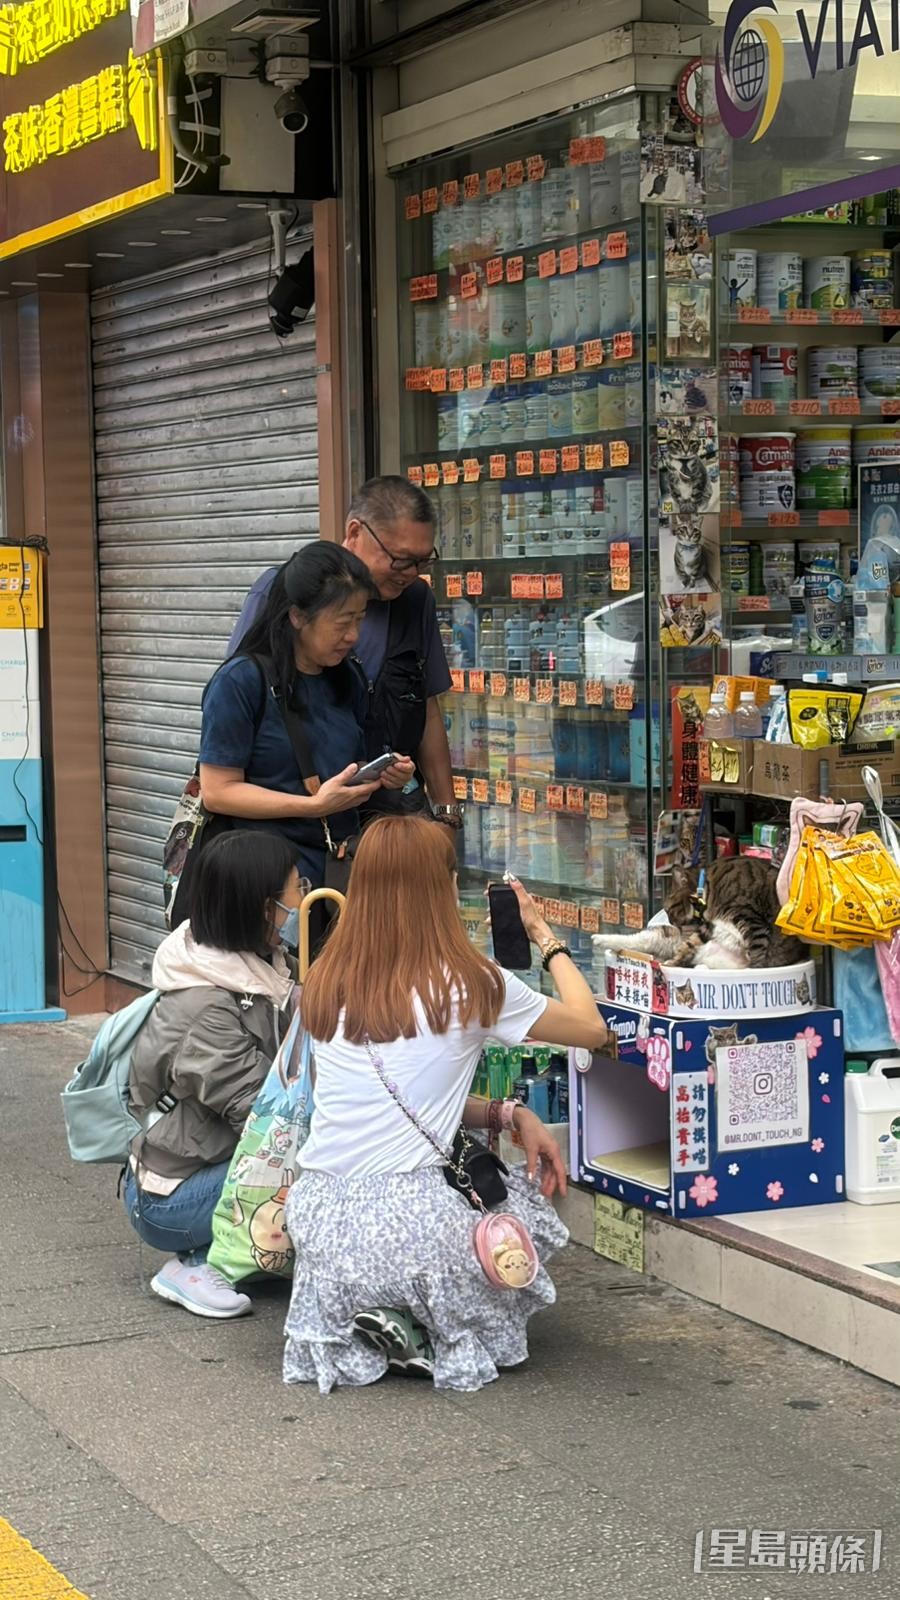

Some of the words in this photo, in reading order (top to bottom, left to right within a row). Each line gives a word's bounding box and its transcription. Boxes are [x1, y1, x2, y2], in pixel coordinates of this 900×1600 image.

[790, 401, 819, 415] $110
[681, 721, 699, 806] 身體健康
[722, 982, 759, 1010] DON'T
[761, 979, 797, 1008] TOUCH
[676, 1085, 691, 1167] 高抬貴手
